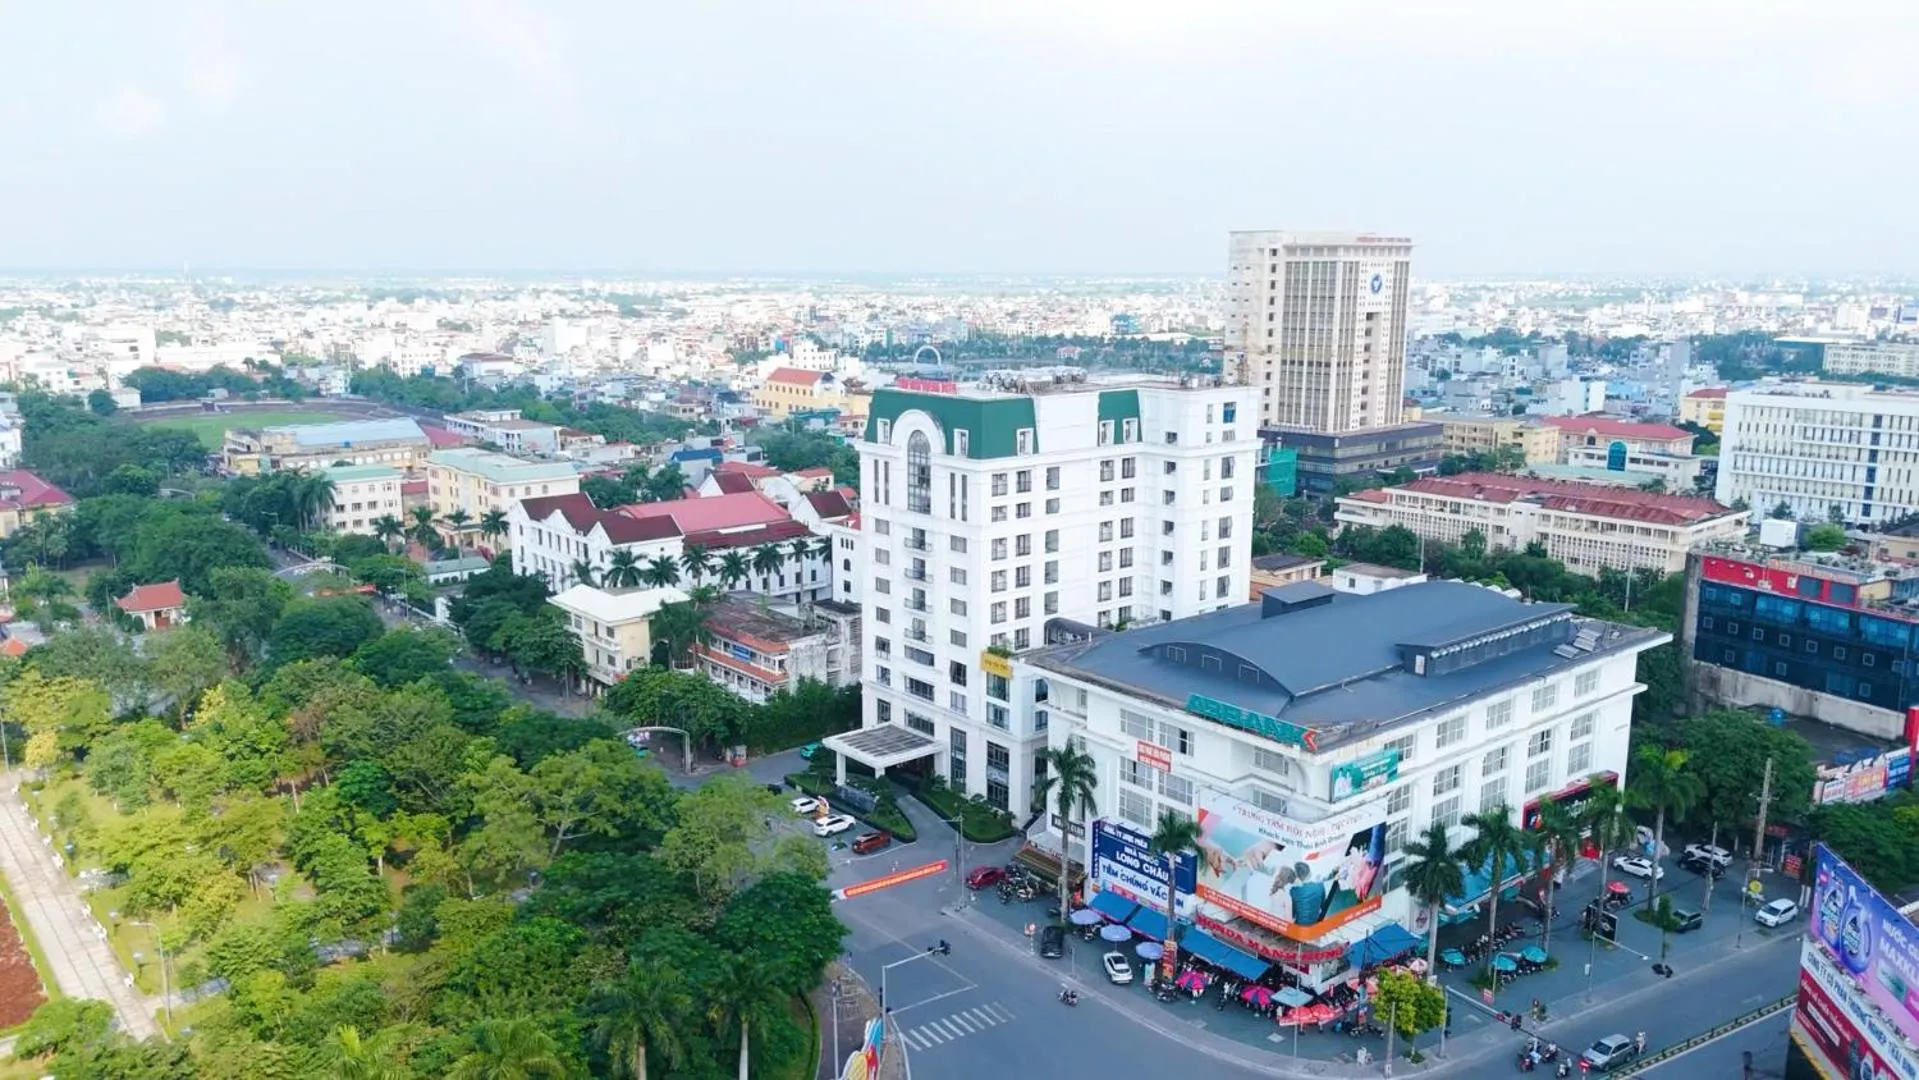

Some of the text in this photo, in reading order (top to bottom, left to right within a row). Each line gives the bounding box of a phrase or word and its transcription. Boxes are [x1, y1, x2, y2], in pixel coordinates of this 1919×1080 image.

[1116, 850, 1169, 881] LONG CHÂU
[1196, 914, 1244, 943] HONDA
